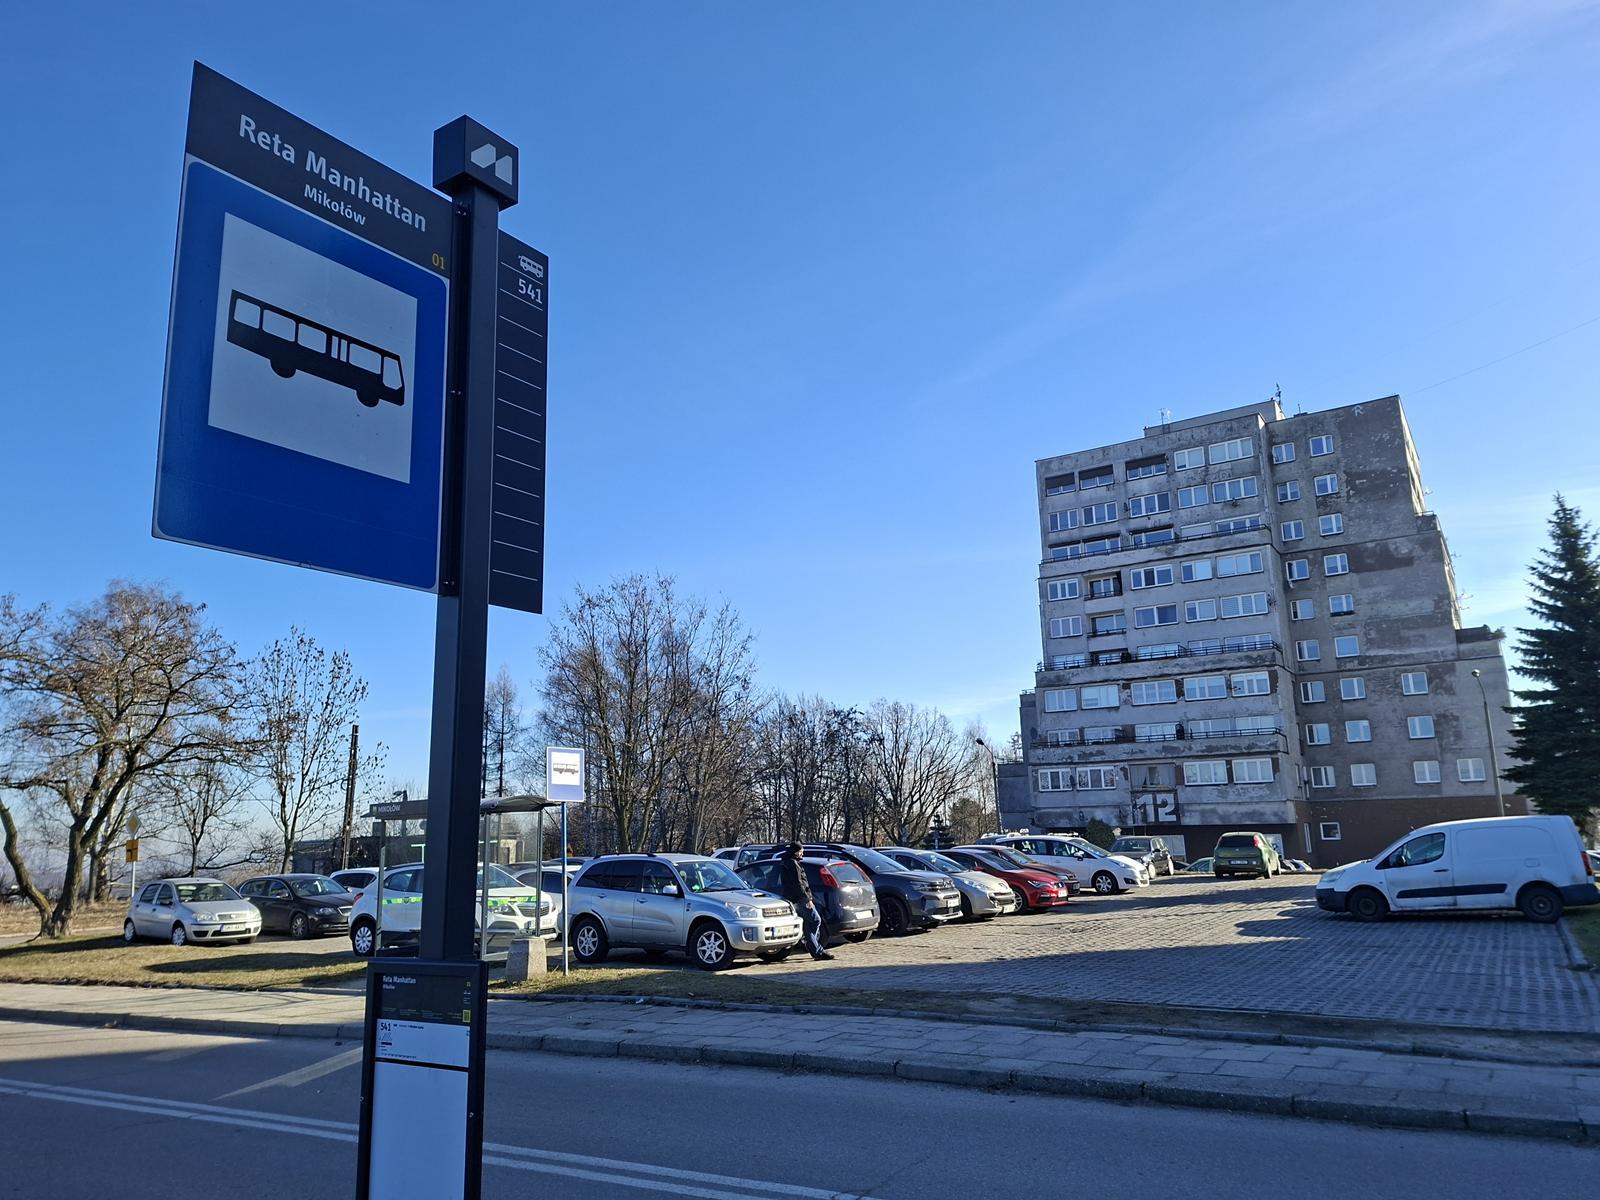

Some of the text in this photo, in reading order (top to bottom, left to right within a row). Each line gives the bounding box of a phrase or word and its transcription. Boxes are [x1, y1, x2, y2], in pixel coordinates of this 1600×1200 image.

[239, 113, 427, 233] Reta Manhattan
[304, 183, 367, 226] Mikołów
[431, 253, 445, 270] 01
[518, 279, 543, 304] 541
[1135, 793, 1177, 822] 12
[380, 1022, 391, 1032] 541
